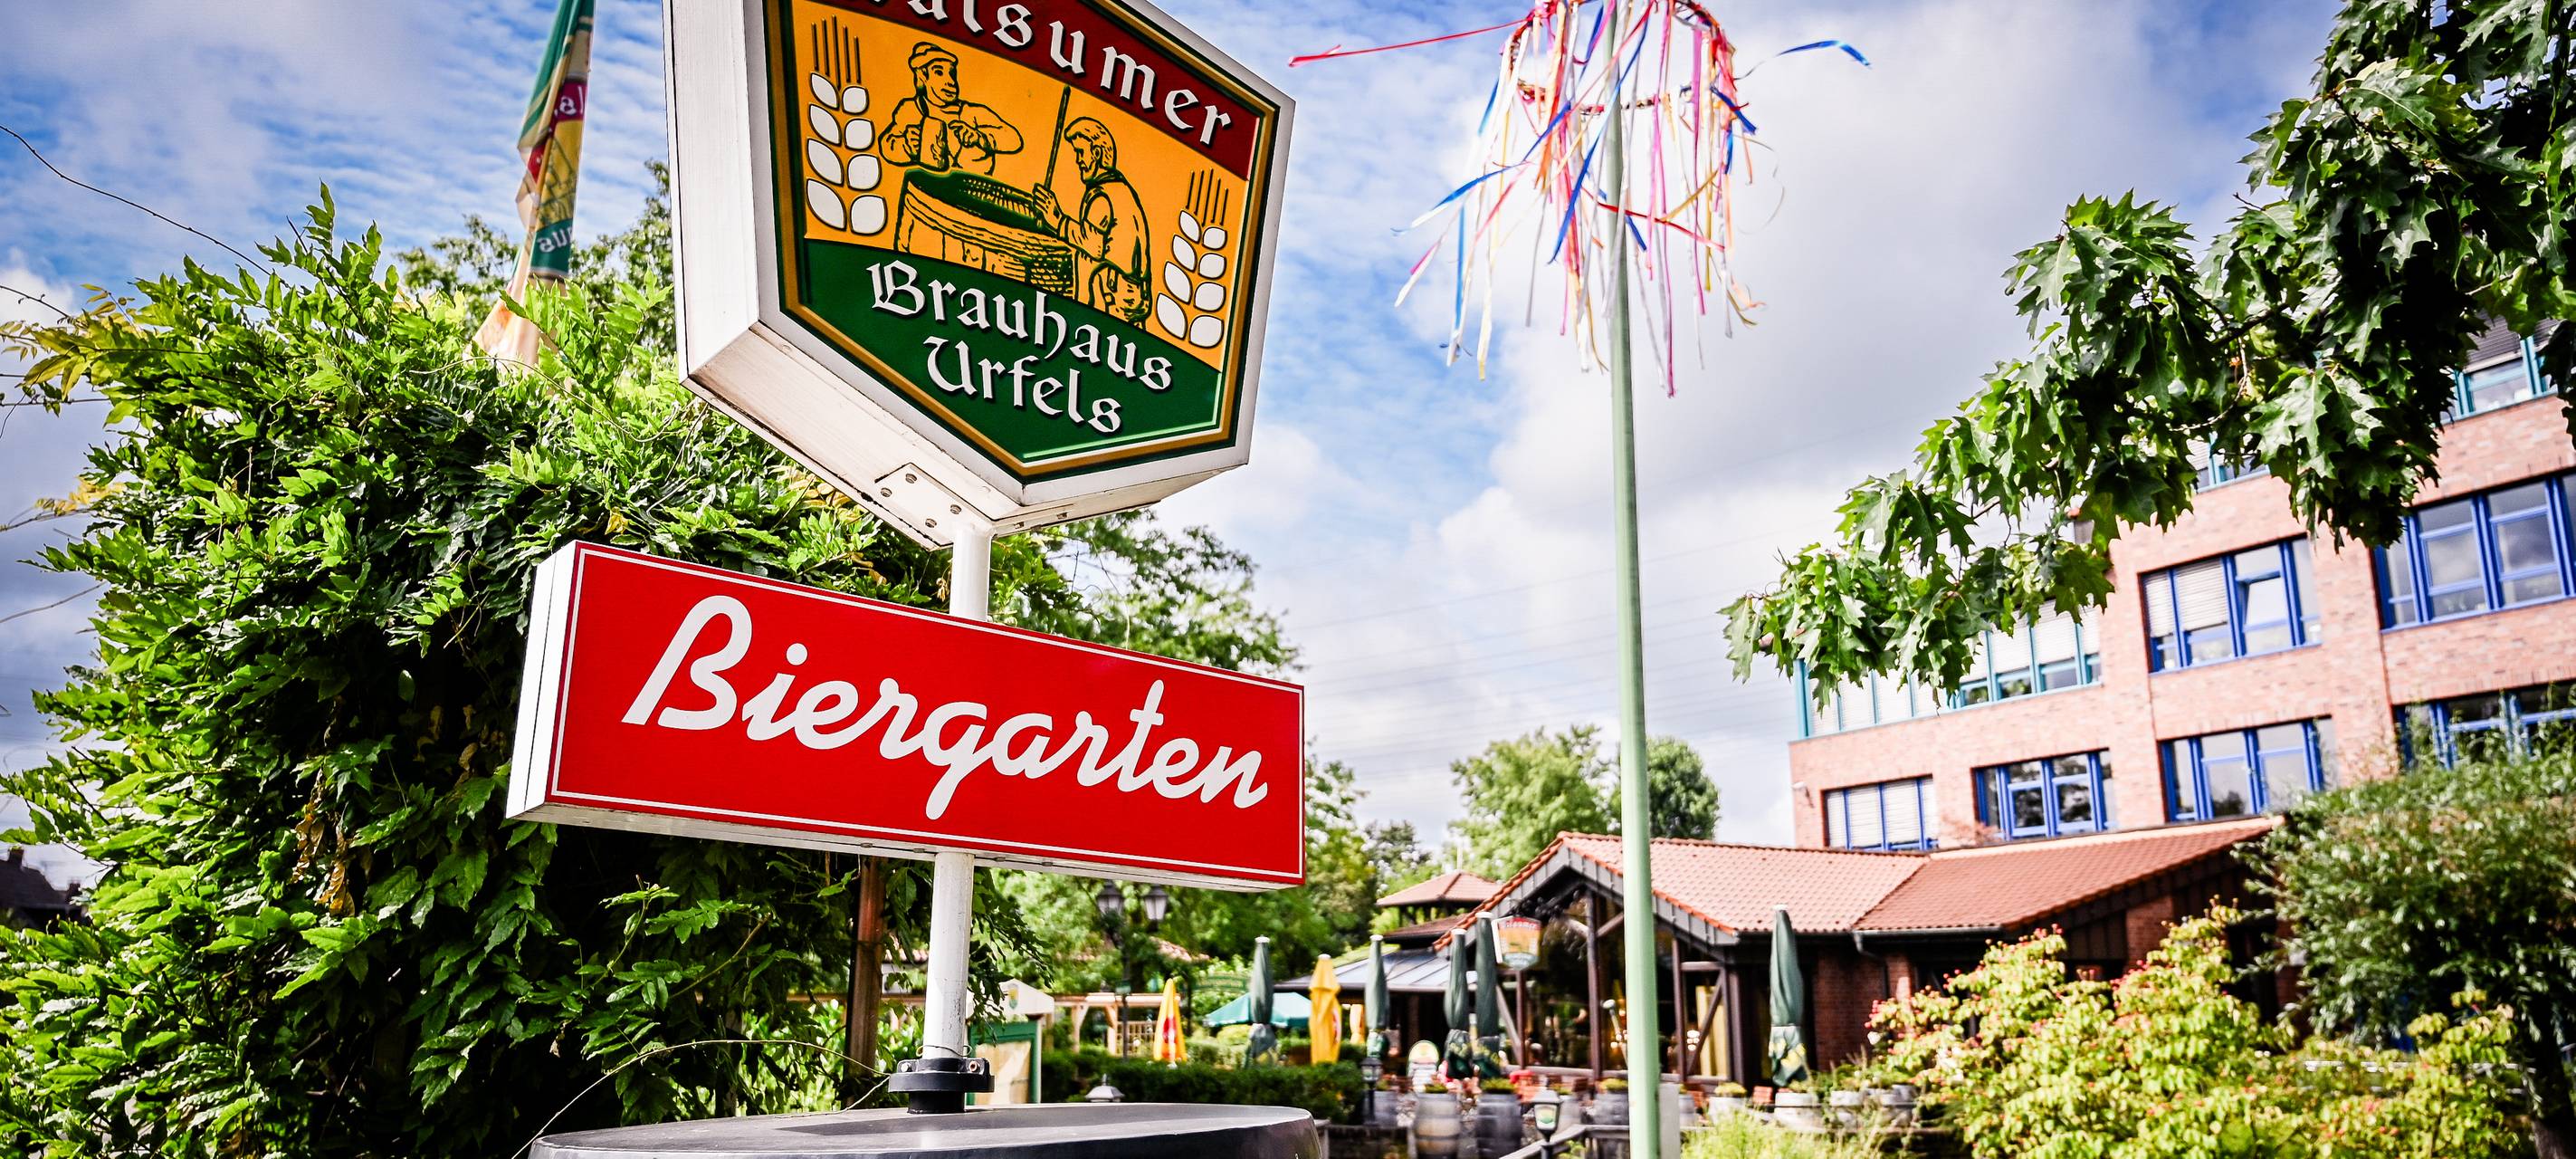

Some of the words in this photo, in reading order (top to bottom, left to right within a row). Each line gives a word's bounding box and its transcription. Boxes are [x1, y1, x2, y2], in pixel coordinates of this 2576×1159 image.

[873, 0, 1232, 146] lsumer
[865, 259, 1174, 391] Brauhaus
[921, 335, 1122, 434] Urfels
[621, 595, 1269, 820] Biergarten
